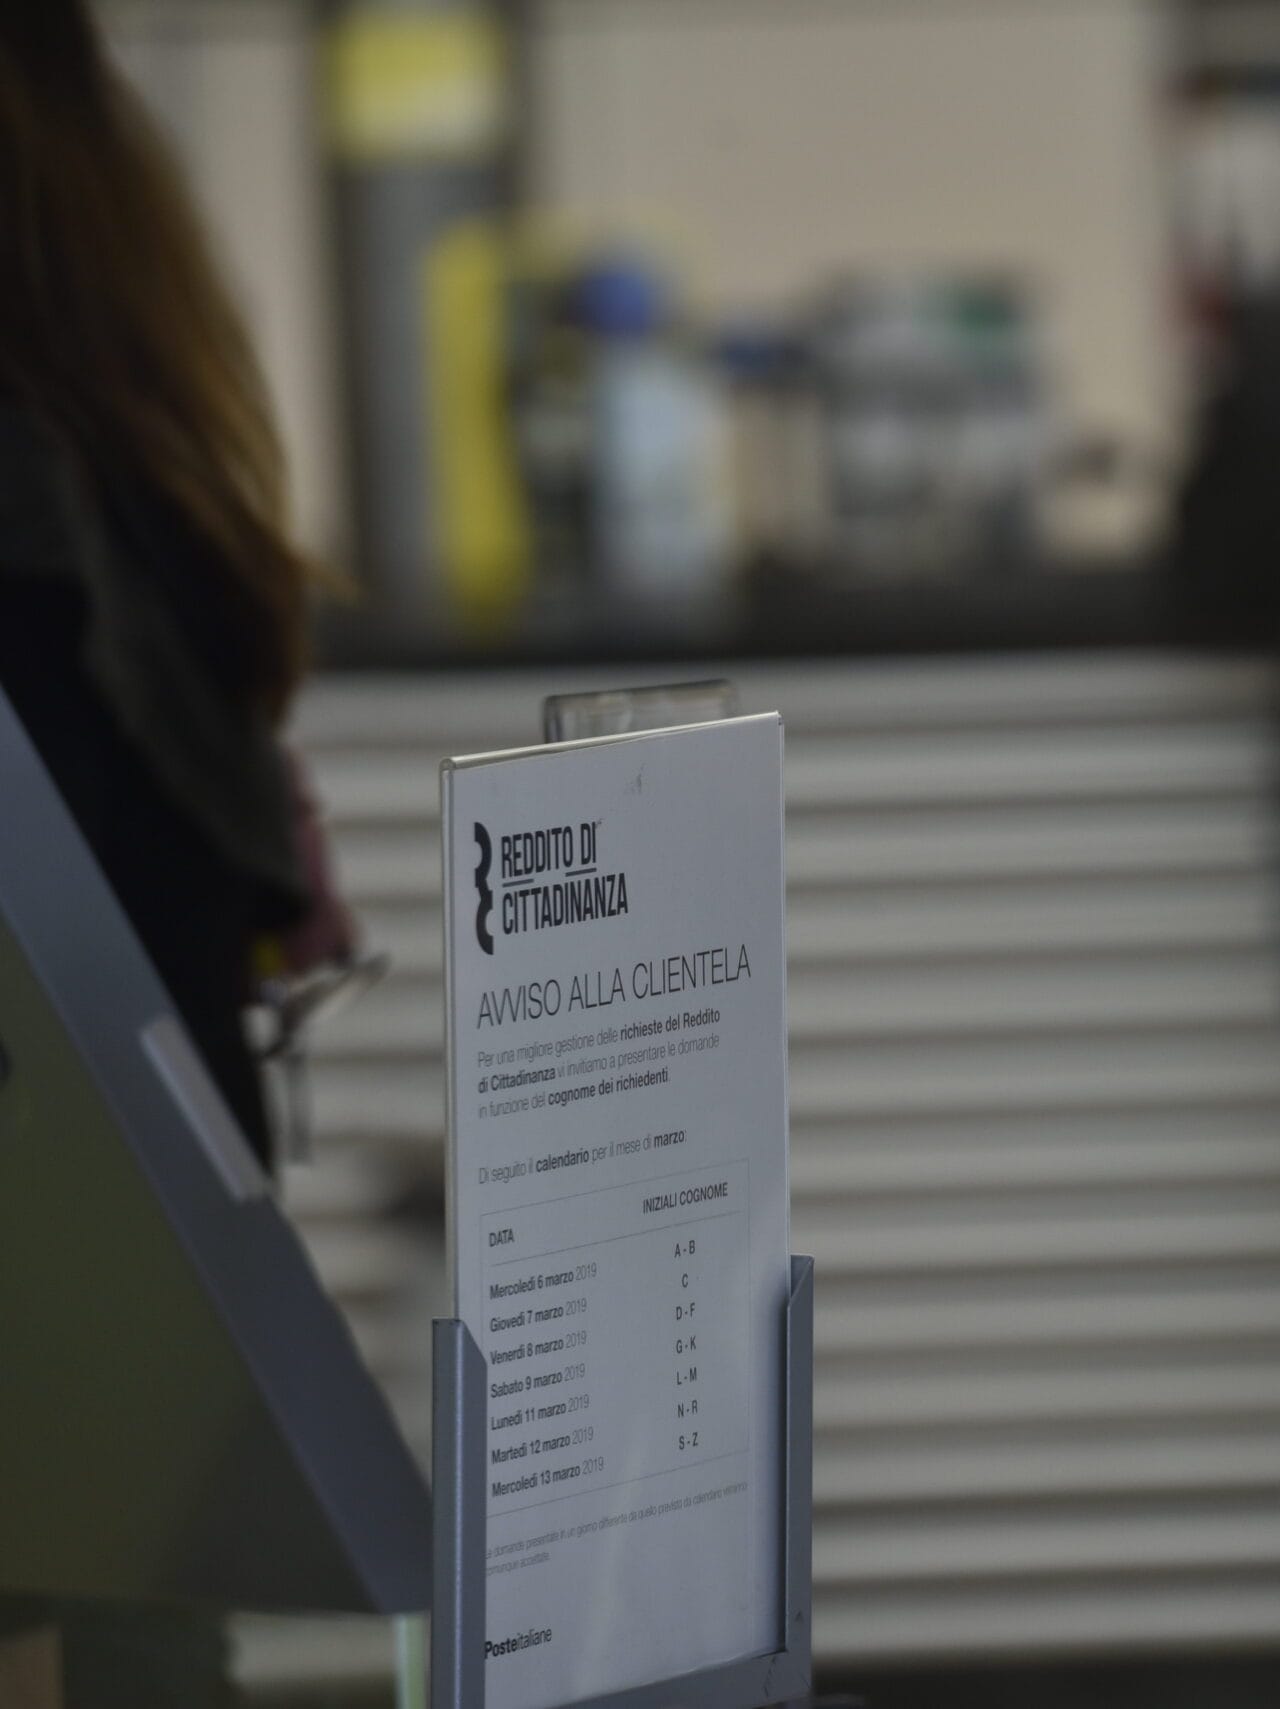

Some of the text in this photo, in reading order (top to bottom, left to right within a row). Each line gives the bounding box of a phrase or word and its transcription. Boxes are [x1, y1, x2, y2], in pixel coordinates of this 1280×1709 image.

[501, 821, 597, 879] REDDITO DI
[502, 873, 629, 935] CITTADINANZA
[476, 943, 752, 1029] AVVISO ALLA CLIENTELA
[478, 1007, 721, 1068] Per una migliore gestione delle richieste del Reddito
[478, 1032, 720, 1094] di Cittadinanza vi invitiamo a presentare le domande
[479, 1103, 488, 1119] in
[489, 1096, 530, 1118] funzione
[531, 1091, 546, 1110] del
[548, 1084, 596, 1107] cognome
[598, 1076, 614, 1096] dei
[478, 1166, 489, 1184] Di
[491, 1160, 527, 1183] seguito
[528, 1157, 534, 1174] il
[536, 1147, 590, 1173] calendario
[591, 1146, 608, 1164] per
[608, 1141, 615, 1158] il
[616, 1138, 641, 1155] mese
[642, 1134, 652, 1151] di
[643, 1182, 729, 1214] INIZIALI COGNOME
[488, 1227, 515, 1248] DATA
[674, 1243, 681, 1258] A
[537, 1274, 544, 1289] 6
[545, 1271, 574, 1288] marzo
[575, 1262, 597, 1281] 2019
[681, 1273, 689, 1288] C
[526, 1309, 533, 1324] 7
[535, 1306, 564, 1322] marzo
[565, 1297, 588, 1316] 2019
[526, 1342, 533, 1357] 8
[535, 1339, 564, 1355] marzo
[565, 1330, 588, 1349] 2019
[491, 1363, 586, 1398] Sabato 9 marzo 2019
[525, 1407, 535, 1423] 11
[537, 1403, 567, 1419] marzo
[568, 1394, 590, 1413] 2019
[530, 1439, 541, 1454] 12
[542, 1435, 571, 1452] marzo
[572, 1426, 594, 1445] 2019
[540, 1469, 551, 1485] 13
[553, 1466, 581, 1482] marzo
[582, 1456, 604, 1475] 2019
[484, 1628, 552, 1660] Posteitaliane
